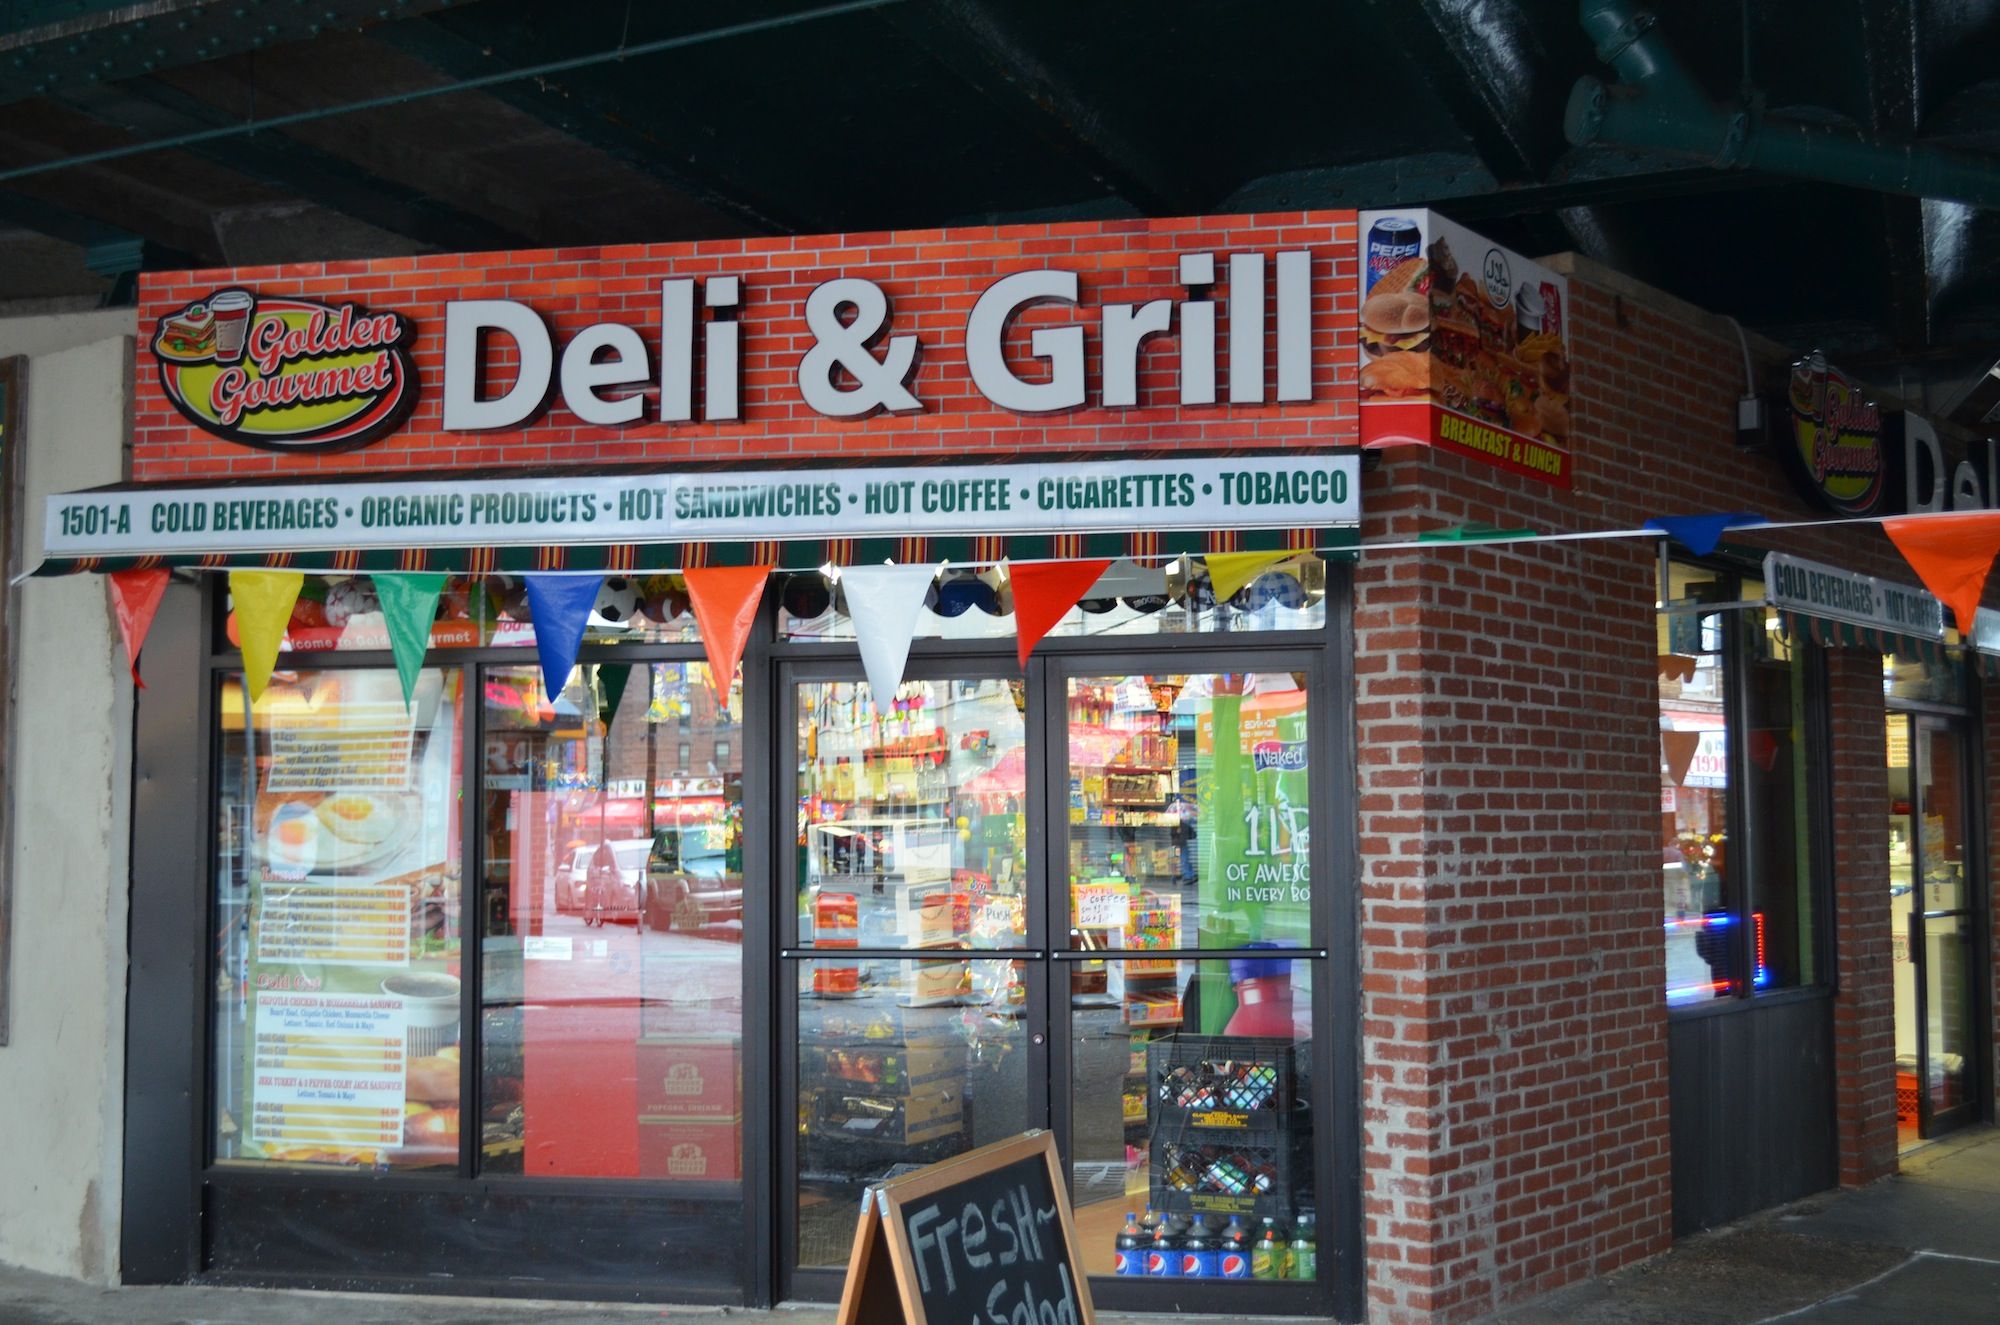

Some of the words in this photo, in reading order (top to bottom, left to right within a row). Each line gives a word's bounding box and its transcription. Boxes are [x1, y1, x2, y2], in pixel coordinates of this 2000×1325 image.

[249, 303, 400, 374] Golden
[442, 276, 742, 432] Deli
[797, 278, 924, 419] &
[965, 250, 1313, 412] Grill
[210, 349, 393, 426] Gourmet
[1440, 413, 1512, 460] BREAKFAST
[1512, 442, 1521, 462] &
[1523, 445, 1561, 476] LUNCH
[1812, 438, 1880, 482] Gourmet
[151, 501, 207, 533] COLD
[213, 497, 339, 531] BEVERAGES
[361, 492, 464, 527] ORGANIC
[470, 490, 596, 525] PRODUCTS
[619, 487, 667, 521] HOT
[674, 482, 841, 519] SANDWICHES
[865, 480, 916, 514] HOT
[921, 478, 1011, 513] COFFEE
[1037, 472, 1195, 510] CIGARETTES
[1219, 469, 1348, 506] TOBACCO
[60, 504, 131, 536] 1501-A
[1774, 561, 1808, 601] COLD
[1808, 570, 1874, 616] BEVERAGES
[1884, 588, 1905, 623] HOT
[291, 638, 334, 650] lcome
[356, 634, 391, 646] Gold
[432, 631, 471, 644] urmet
[1259, 746, 1303, 766] Naked
[1226, 863, 1250, 882] OF
[1228, 888, 1241, 901] IN
[1246, 887, 1286, 902] EVERY
[1292, 887, 1310, 903] BO
[985, 907, 1011, 921] PUSH
[257, 974, 290, 991] Cold
[369, 999, 403, 1010] SANDWICH
[353, 1079, 368, 1090] JACK
[369, 1080, 402, 1091] SANDWICH
